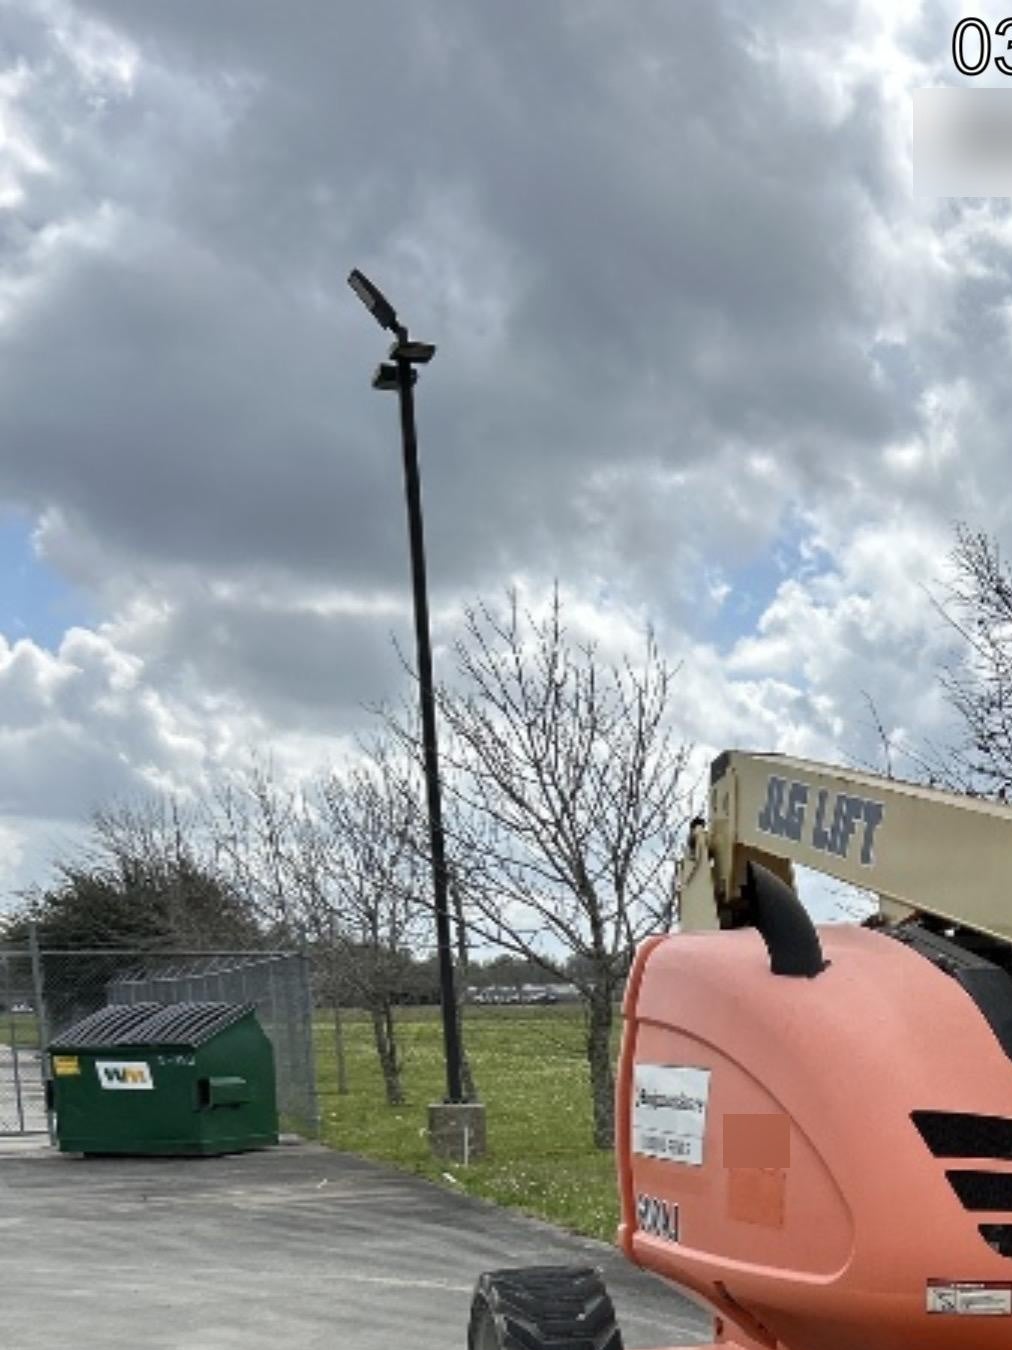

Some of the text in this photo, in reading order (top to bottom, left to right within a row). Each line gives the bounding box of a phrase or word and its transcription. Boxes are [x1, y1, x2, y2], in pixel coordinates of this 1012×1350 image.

[757, 775, 883, 864] JLG LIFT
[103, 1066, 147, 1084] WM
